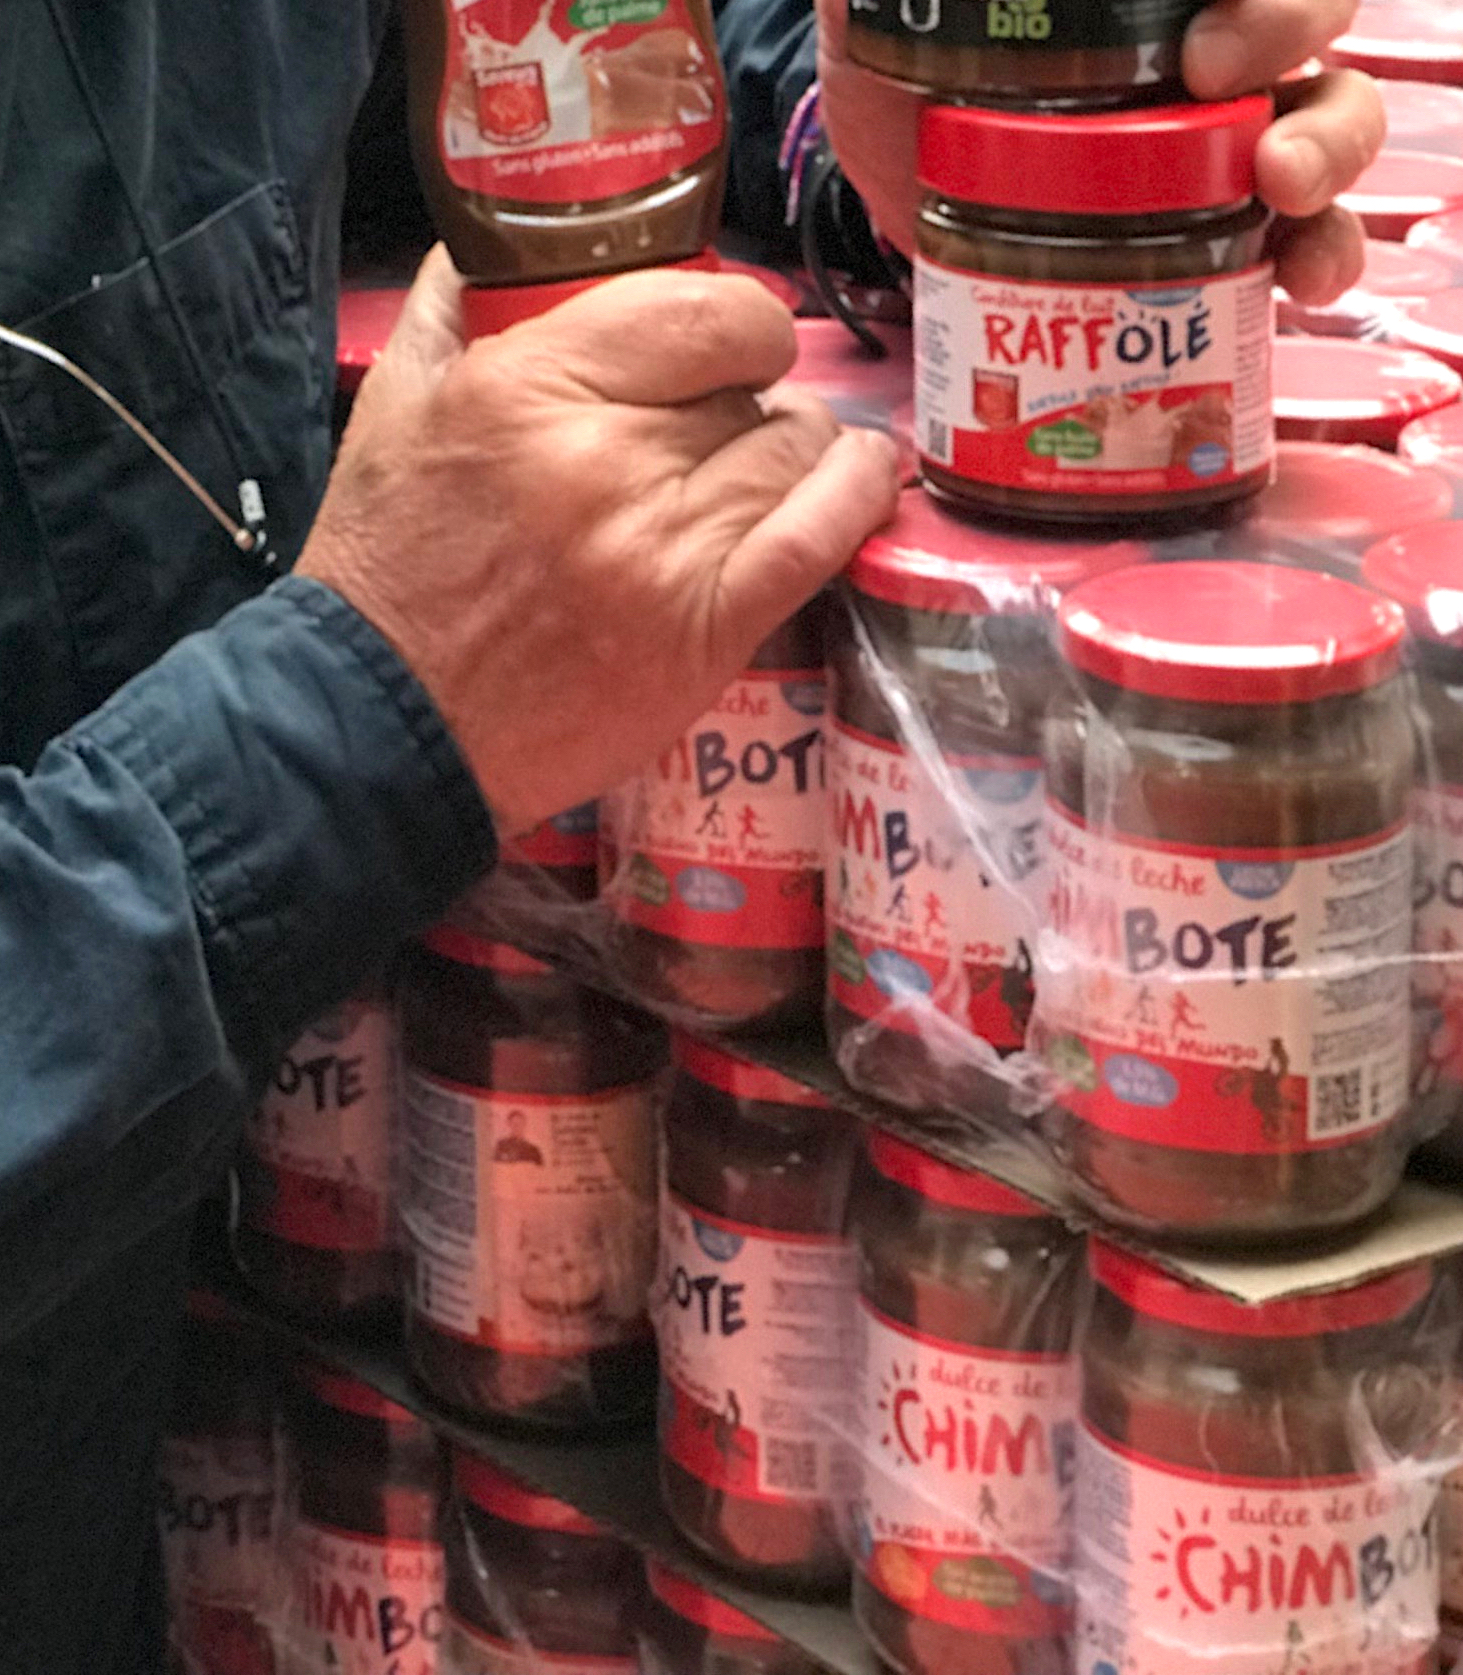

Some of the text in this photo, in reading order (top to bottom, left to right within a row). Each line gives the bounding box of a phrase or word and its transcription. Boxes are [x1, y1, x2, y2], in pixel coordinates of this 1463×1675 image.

[987, 0, 1053, 40] bio
[1051, 292, 1075, 312] de
[1130, 854, 1207, 897] leche
[928, 1357, 1049, 1400] dulce de
[1227, 1495, 1311, 1526] dulce
[1322, 1495, 1356, 1524] de
